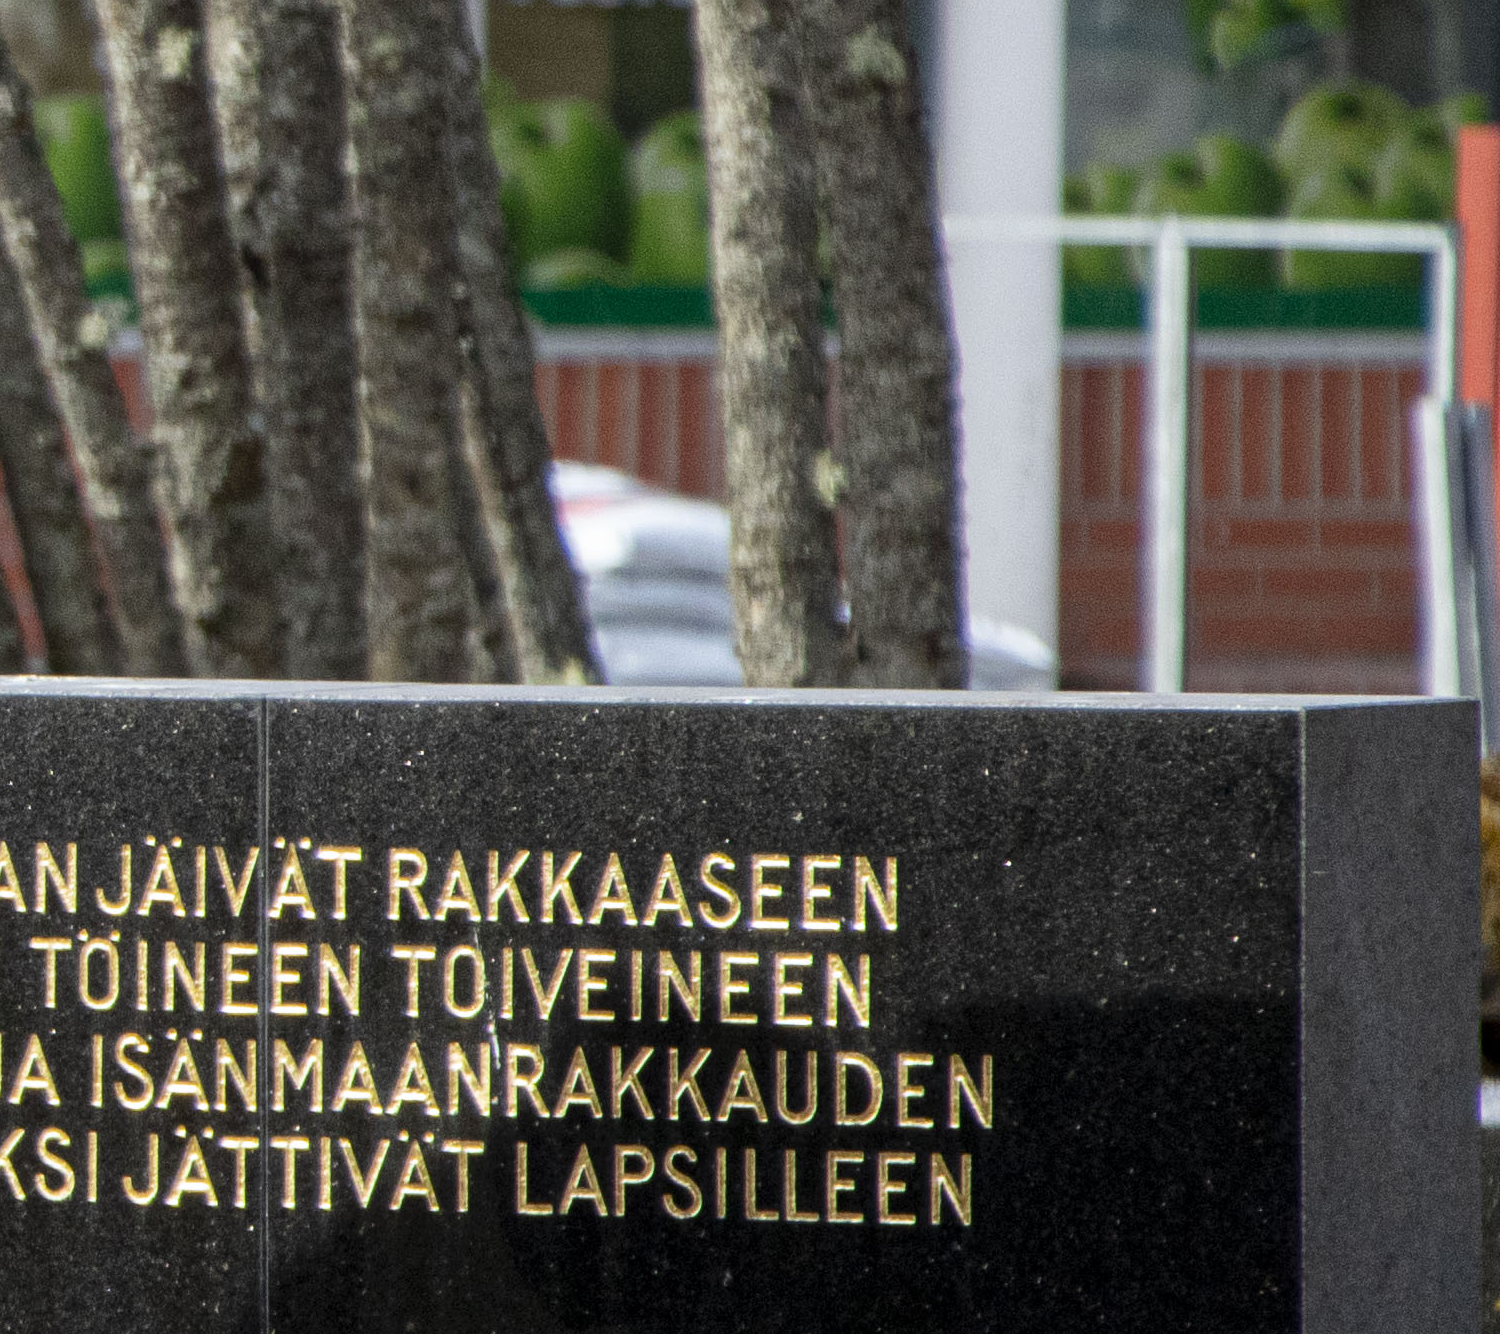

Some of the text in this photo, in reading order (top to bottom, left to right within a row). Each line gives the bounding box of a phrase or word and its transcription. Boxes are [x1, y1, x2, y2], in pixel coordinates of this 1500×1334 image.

[95, 835, 362, 924] JÄIVÄT
[386, 847, 897, 932] RAKKAASEEN
[29, 929, 360, 1016] TÖINEEN
[390, 939, 871, 1032] TOIVEINEEN
[90, 1027, 993, 1134] ISÄNMAANRAKKAUDEN
[122, 1125, 484, 1214] JÄTTIVÄT
[516, 1141, 972, 1226] LAPSILLEEN
